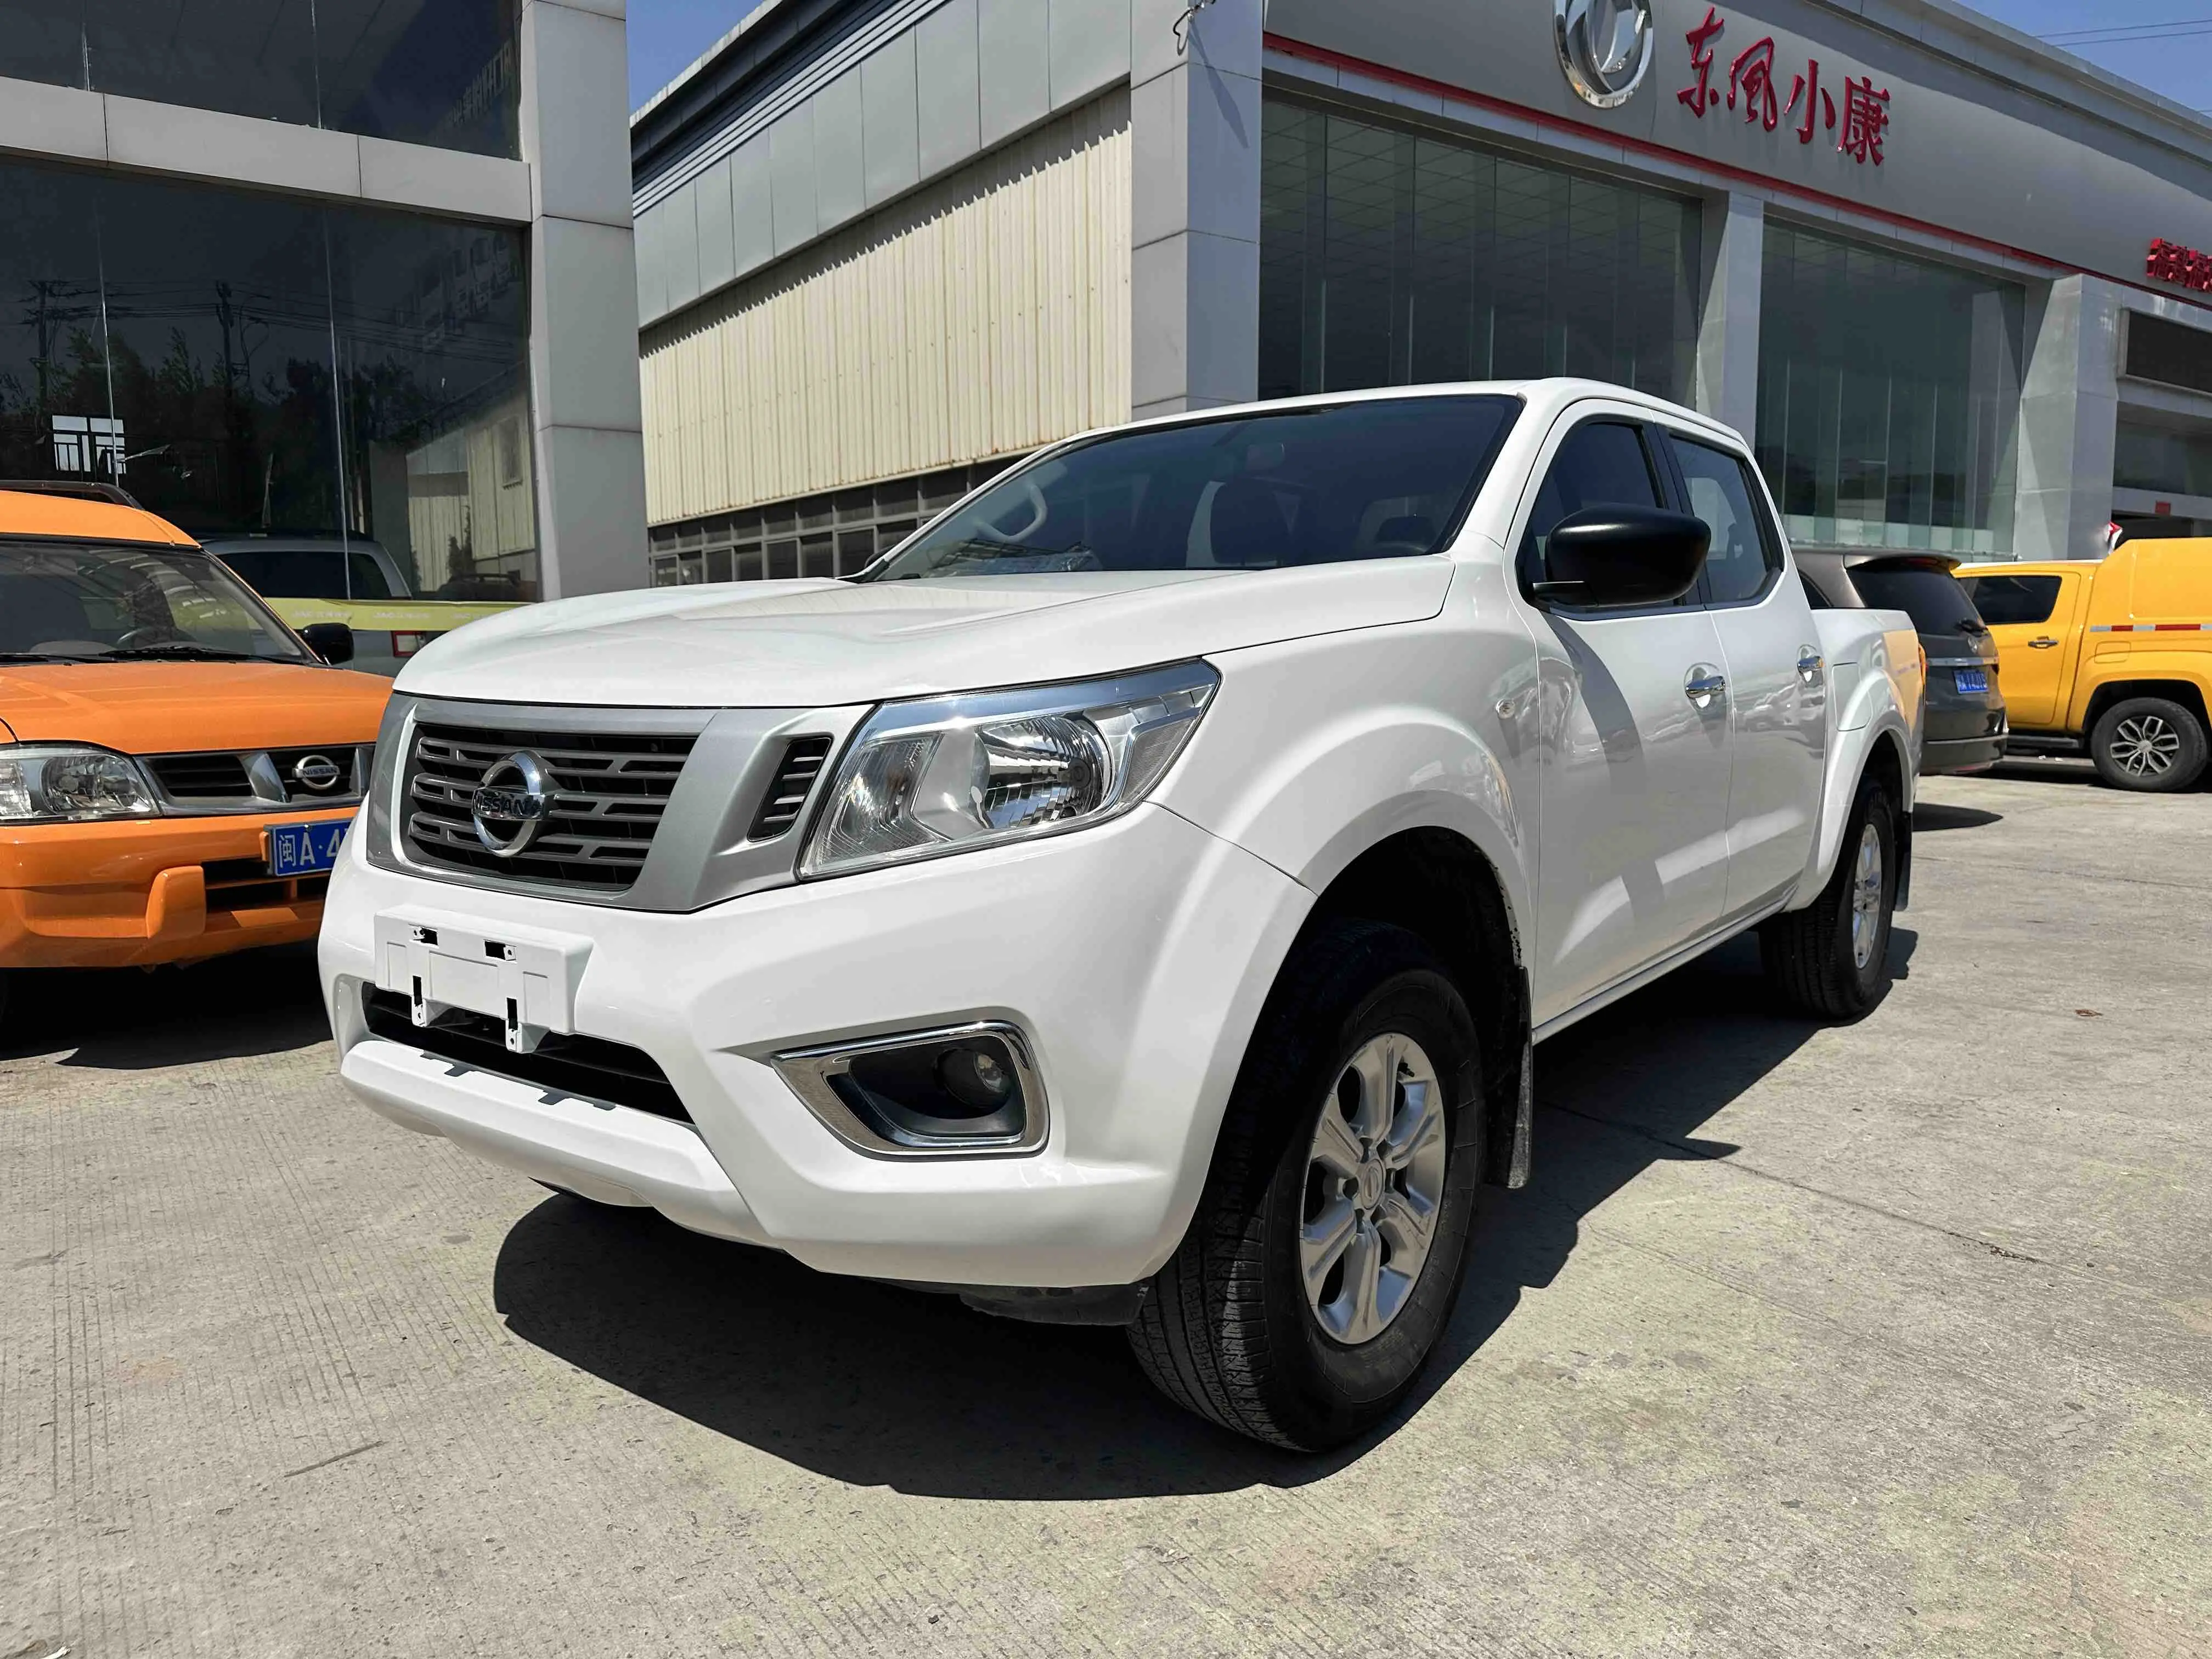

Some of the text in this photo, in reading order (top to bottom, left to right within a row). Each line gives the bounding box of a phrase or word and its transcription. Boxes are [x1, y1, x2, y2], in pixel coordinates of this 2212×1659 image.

[1677, 7, 1890, 166] 东风小康
[279, 828, 349, 868] 闽A·4
